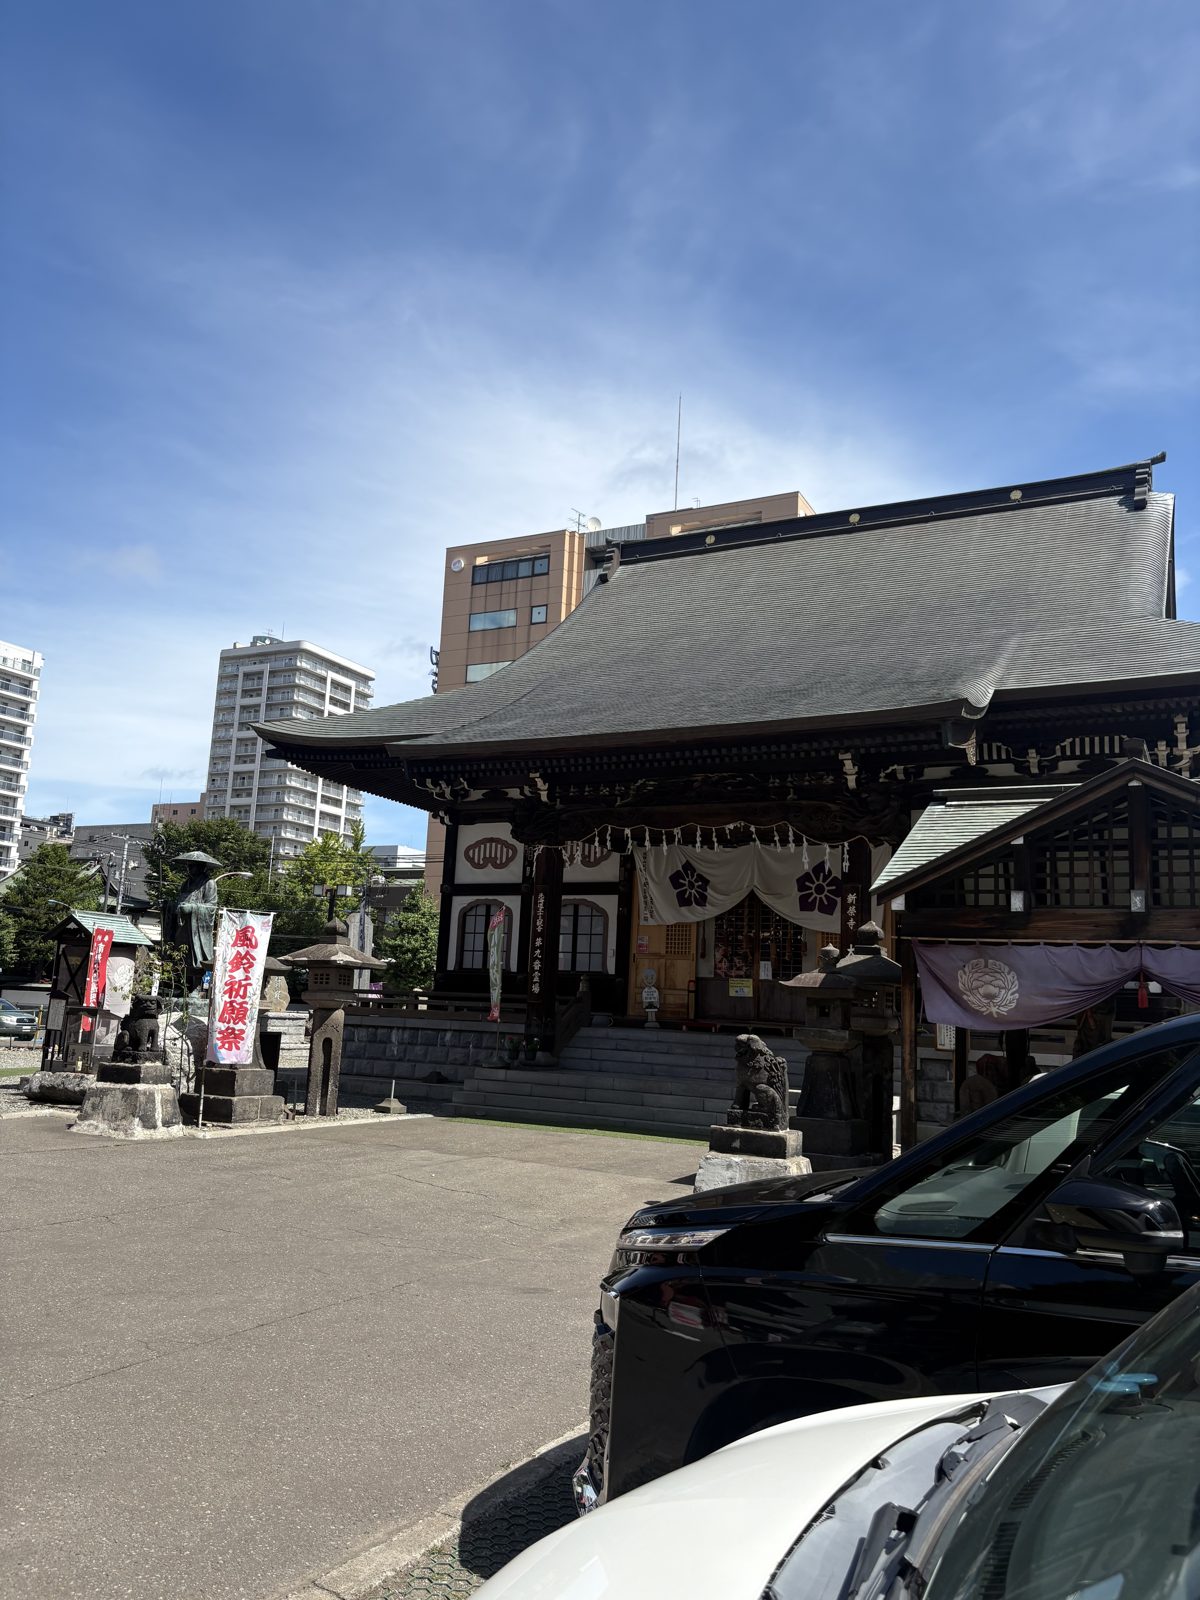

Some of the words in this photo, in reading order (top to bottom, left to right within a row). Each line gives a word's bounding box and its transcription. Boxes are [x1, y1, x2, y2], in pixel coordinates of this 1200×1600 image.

[215, 925, 259, 1052] 風鈴祈願祭
